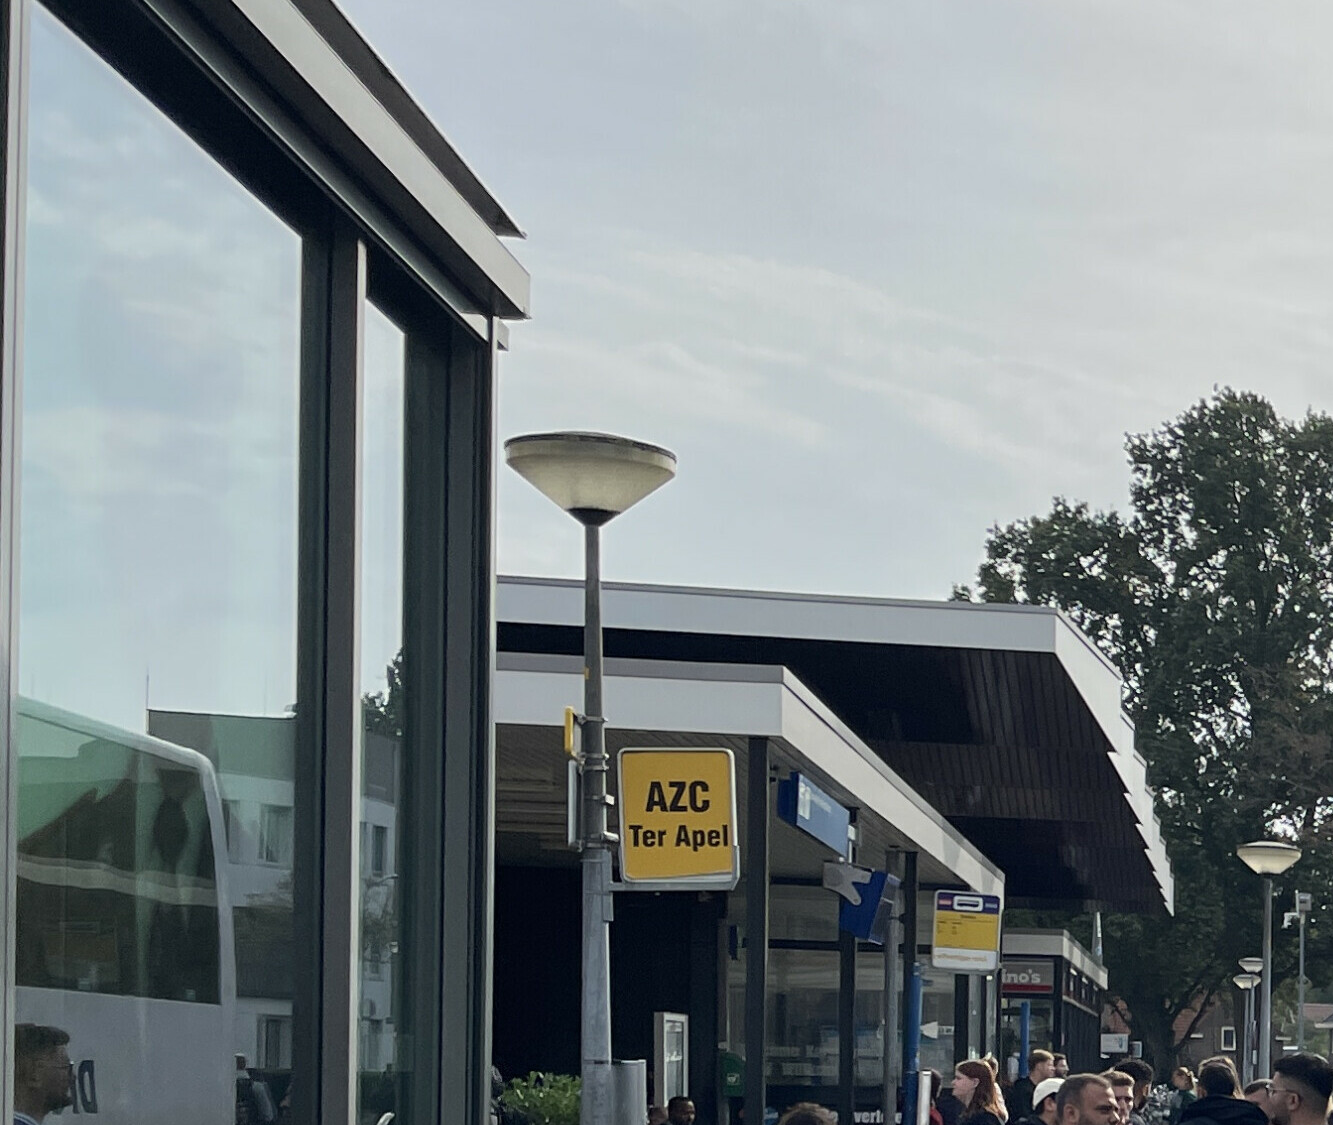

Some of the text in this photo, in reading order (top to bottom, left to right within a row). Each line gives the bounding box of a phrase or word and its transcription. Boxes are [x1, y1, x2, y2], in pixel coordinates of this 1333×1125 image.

[645, 780, 710, 812] AZC
[628, 824, 729, 852] Ter Apel
[1001, 968, 1041, 984] ino's
